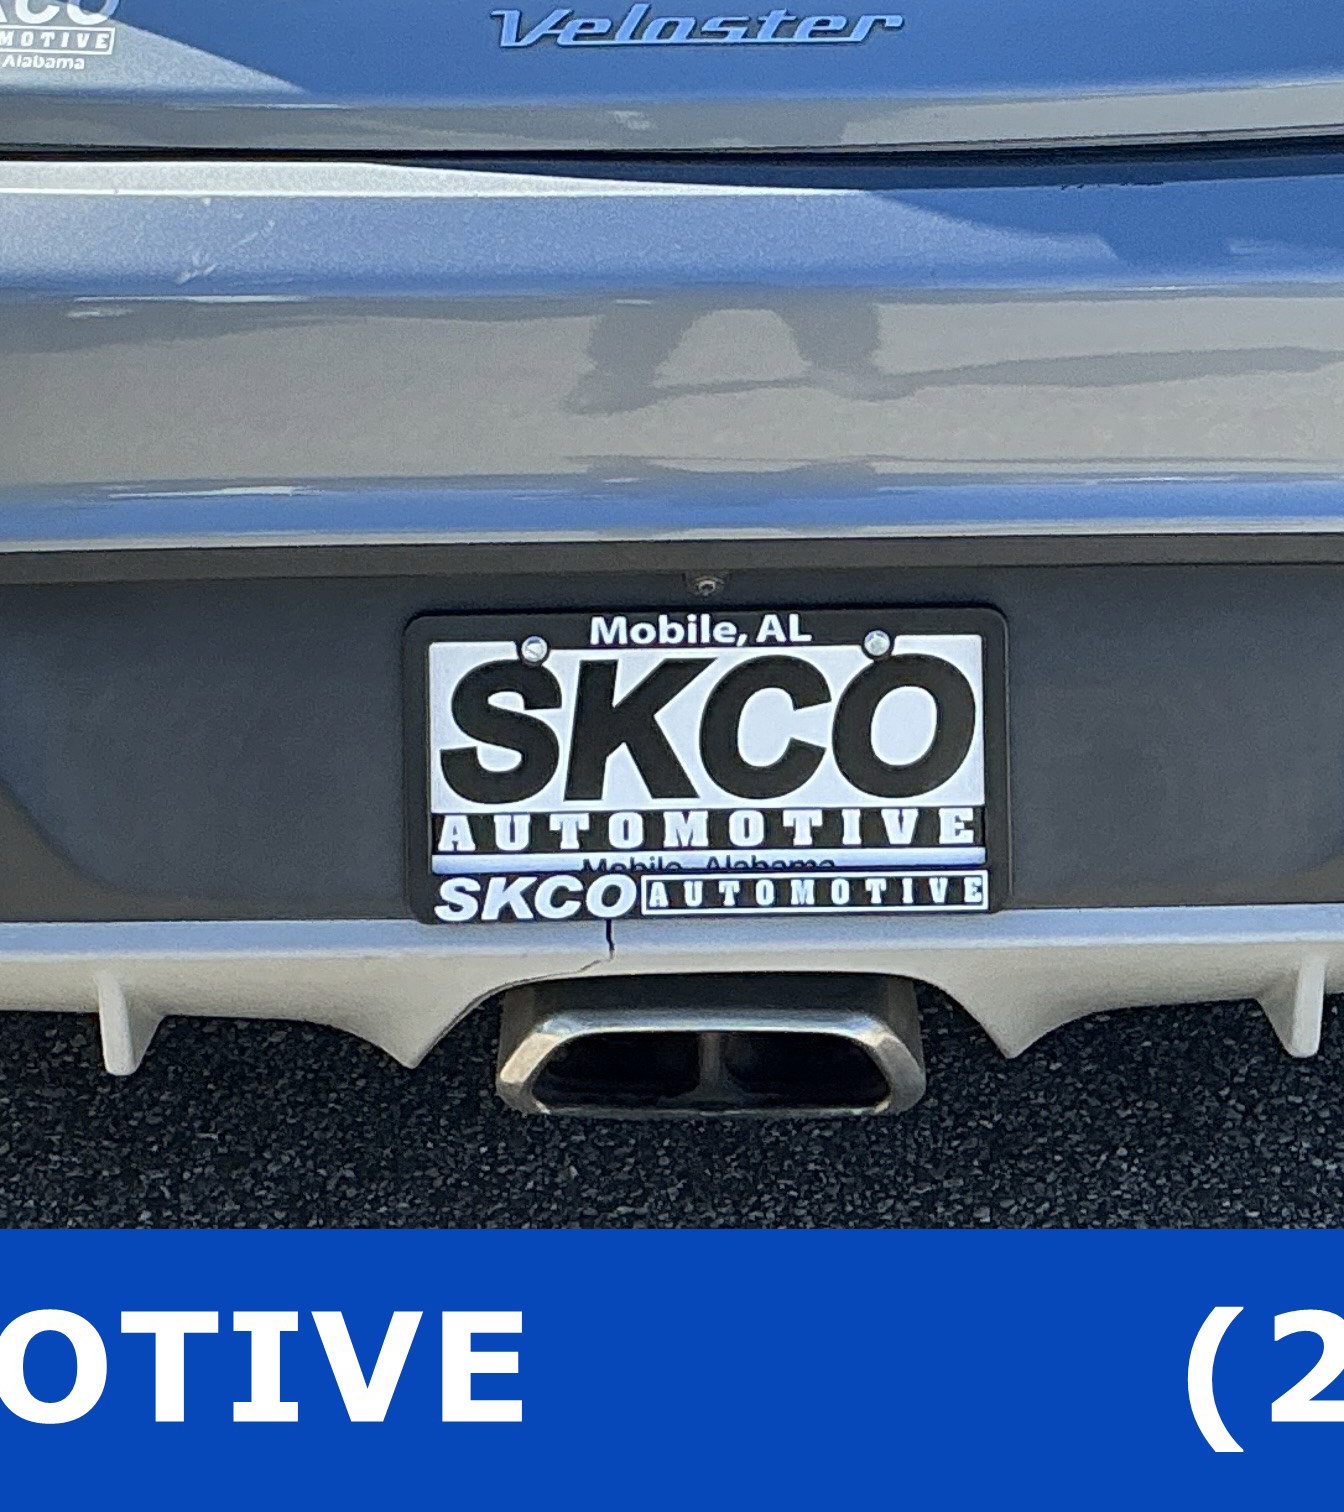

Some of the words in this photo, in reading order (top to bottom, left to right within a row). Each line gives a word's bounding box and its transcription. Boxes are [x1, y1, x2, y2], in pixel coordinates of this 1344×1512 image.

[490, 3, 903, 48] Veloster
[2, 55, 85, 70] Alabama
[590, 615, 746, 646] Mobile,
[757, 614, 812, 643] AL
[440, 654, 976, 804] SKCO
[438, 808, 975, 853] AUTOMOTIVE
[434, 875, 639, 921] SKCO
[648, 877, 983, 909] AUTOMOTIVE
